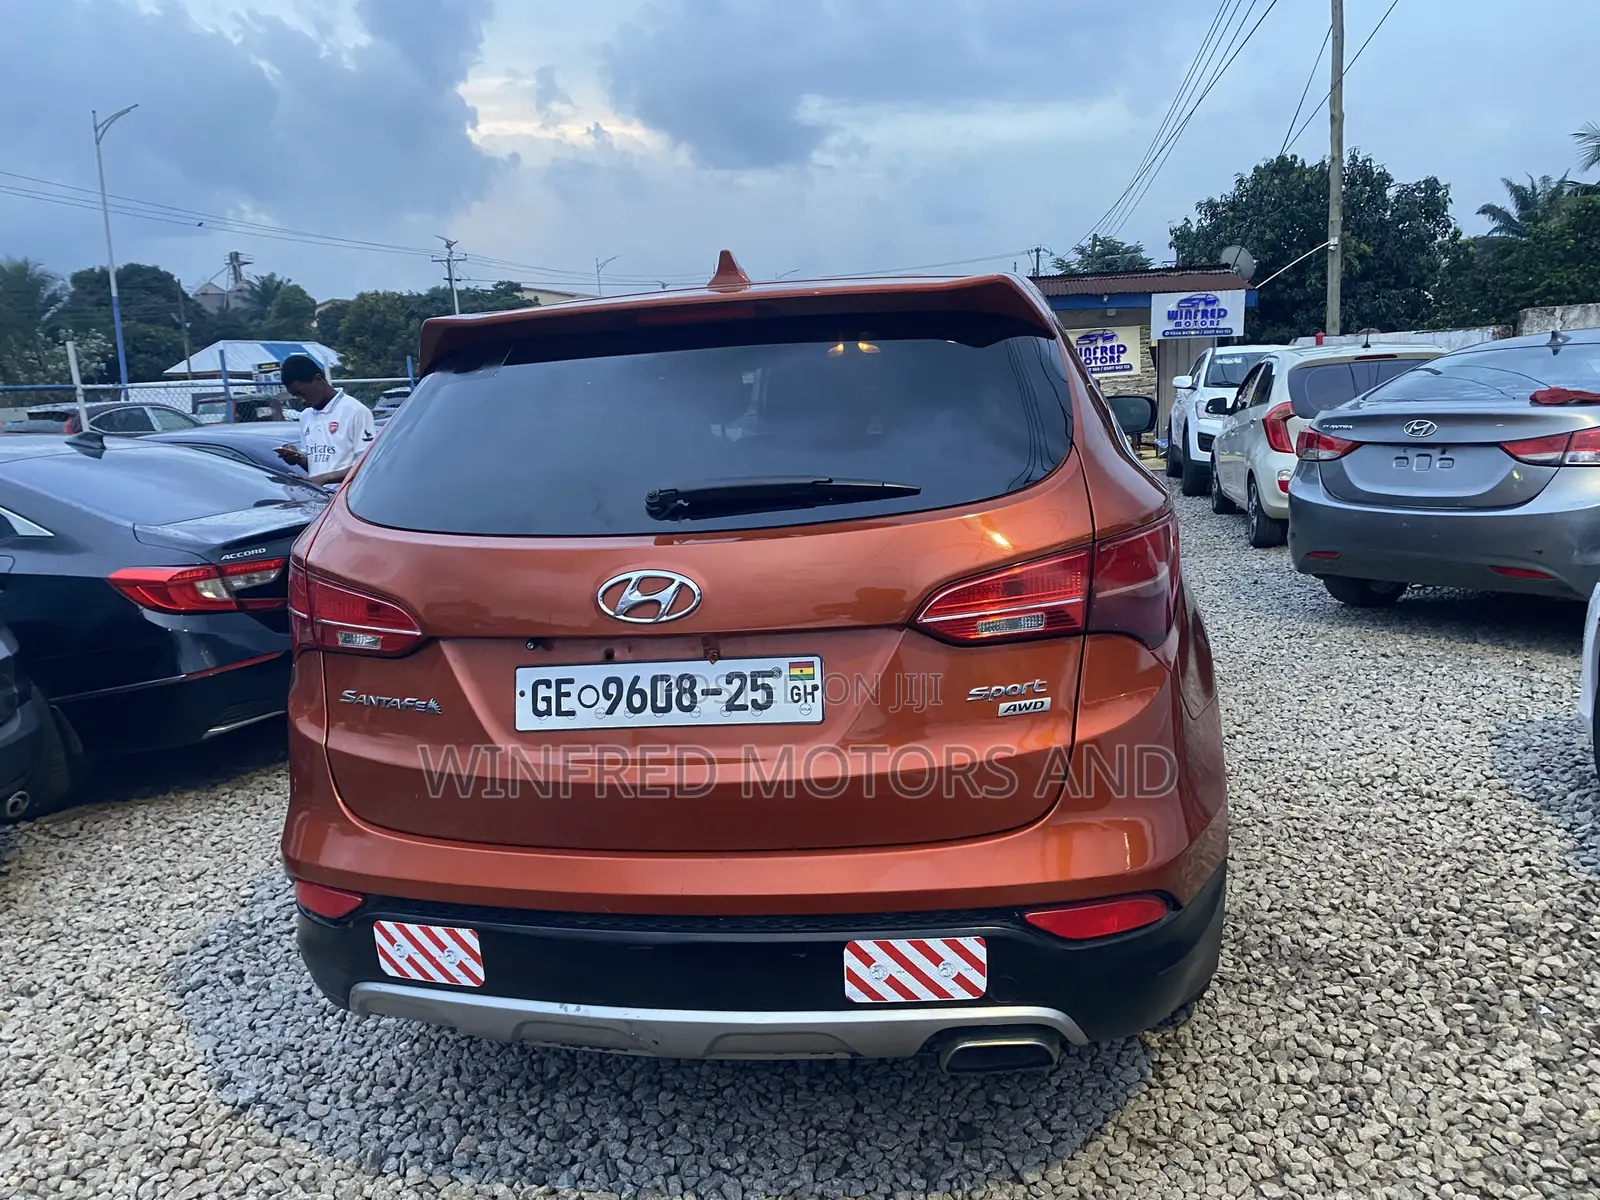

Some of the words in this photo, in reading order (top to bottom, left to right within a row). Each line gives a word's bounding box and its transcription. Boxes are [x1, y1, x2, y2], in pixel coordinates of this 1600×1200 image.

[1167, 308, 1228, 320] WINFRED
[1174, 319, 1220, 328] MOTORS
[1075, 343, 1128, 358] INFRED
[1083, 354, 1121, 366] OTORS
[221, 548, 266, 560] ACCORD
[531, 677, 577, 718] GE
[602, 669, 775, 716] 9608-25
[790, 684, 818, 703] GH
[966, 679, 1047, 702] Sport
[1003, 701, 1045, 714] AWD
